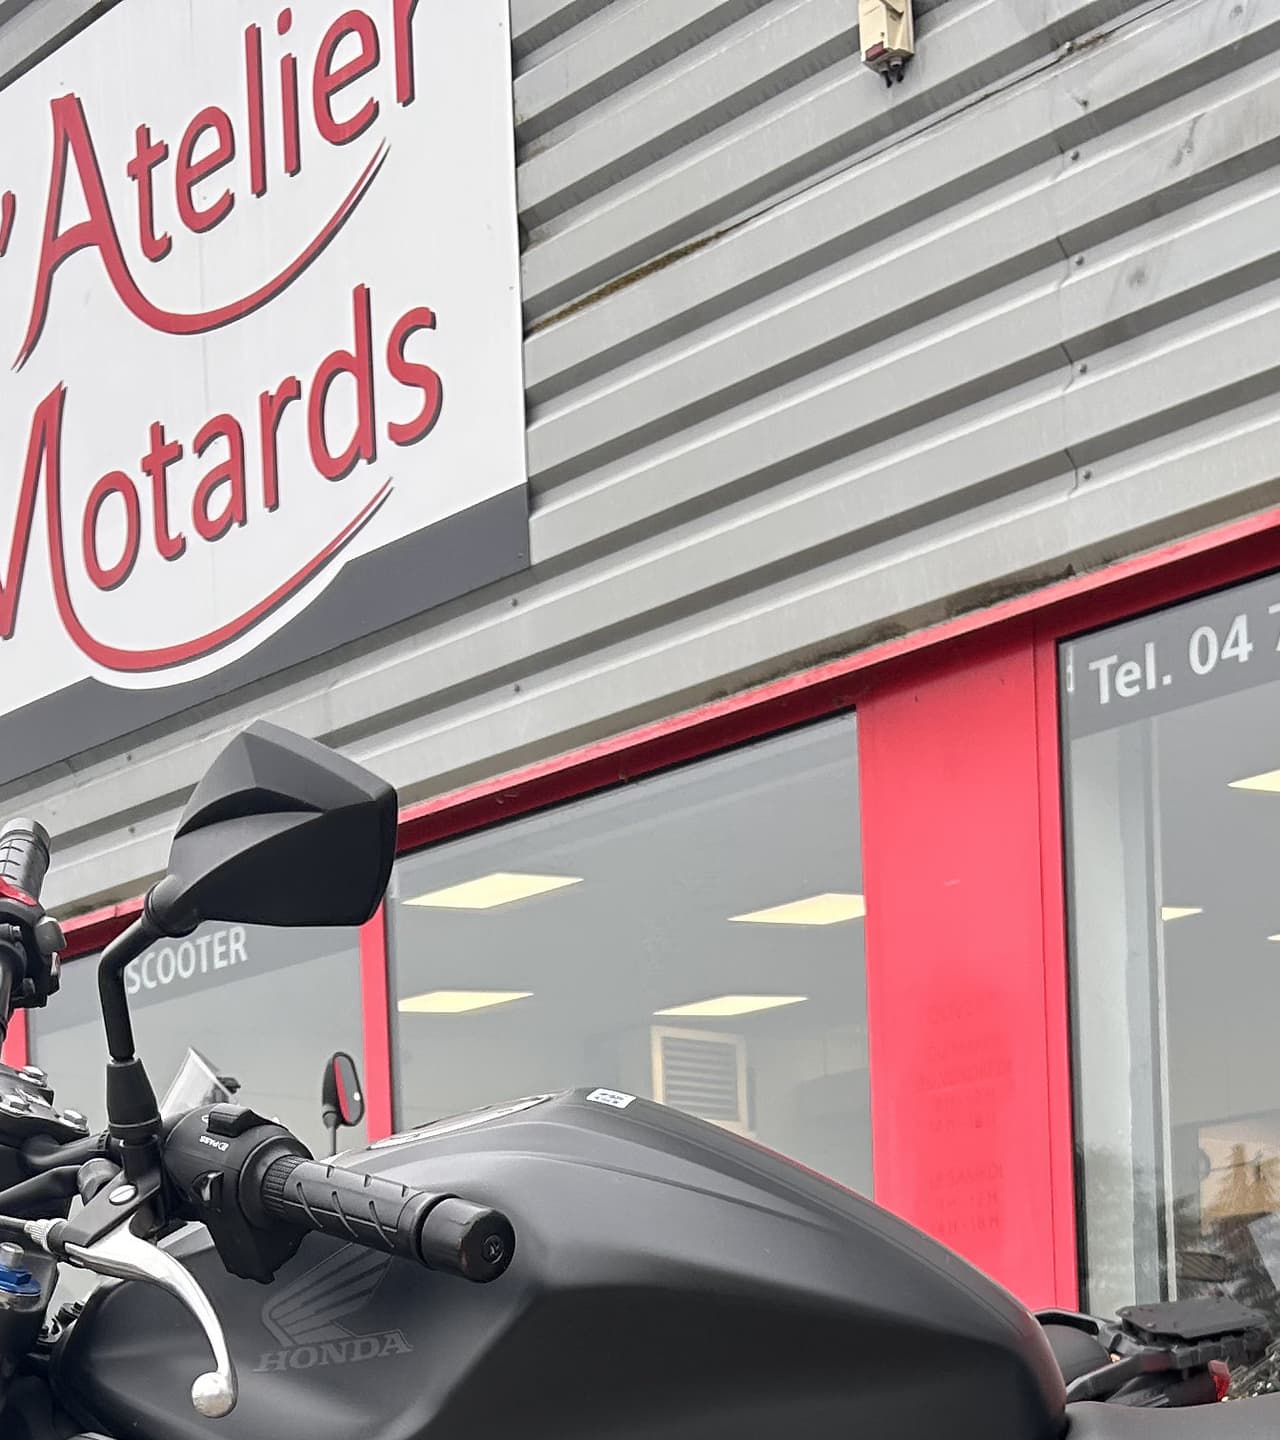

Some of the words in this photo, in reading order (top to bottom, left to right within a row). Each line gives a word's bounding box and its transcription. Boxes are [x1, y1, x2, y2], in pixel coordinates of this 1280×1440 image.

[1087, 640, 1173, 705] Tel.
[1188, 613, 1254, 676] 04
[125, 925, 249, 994] SCOOTER
[252, 1329, 415, 1374] HONDA
